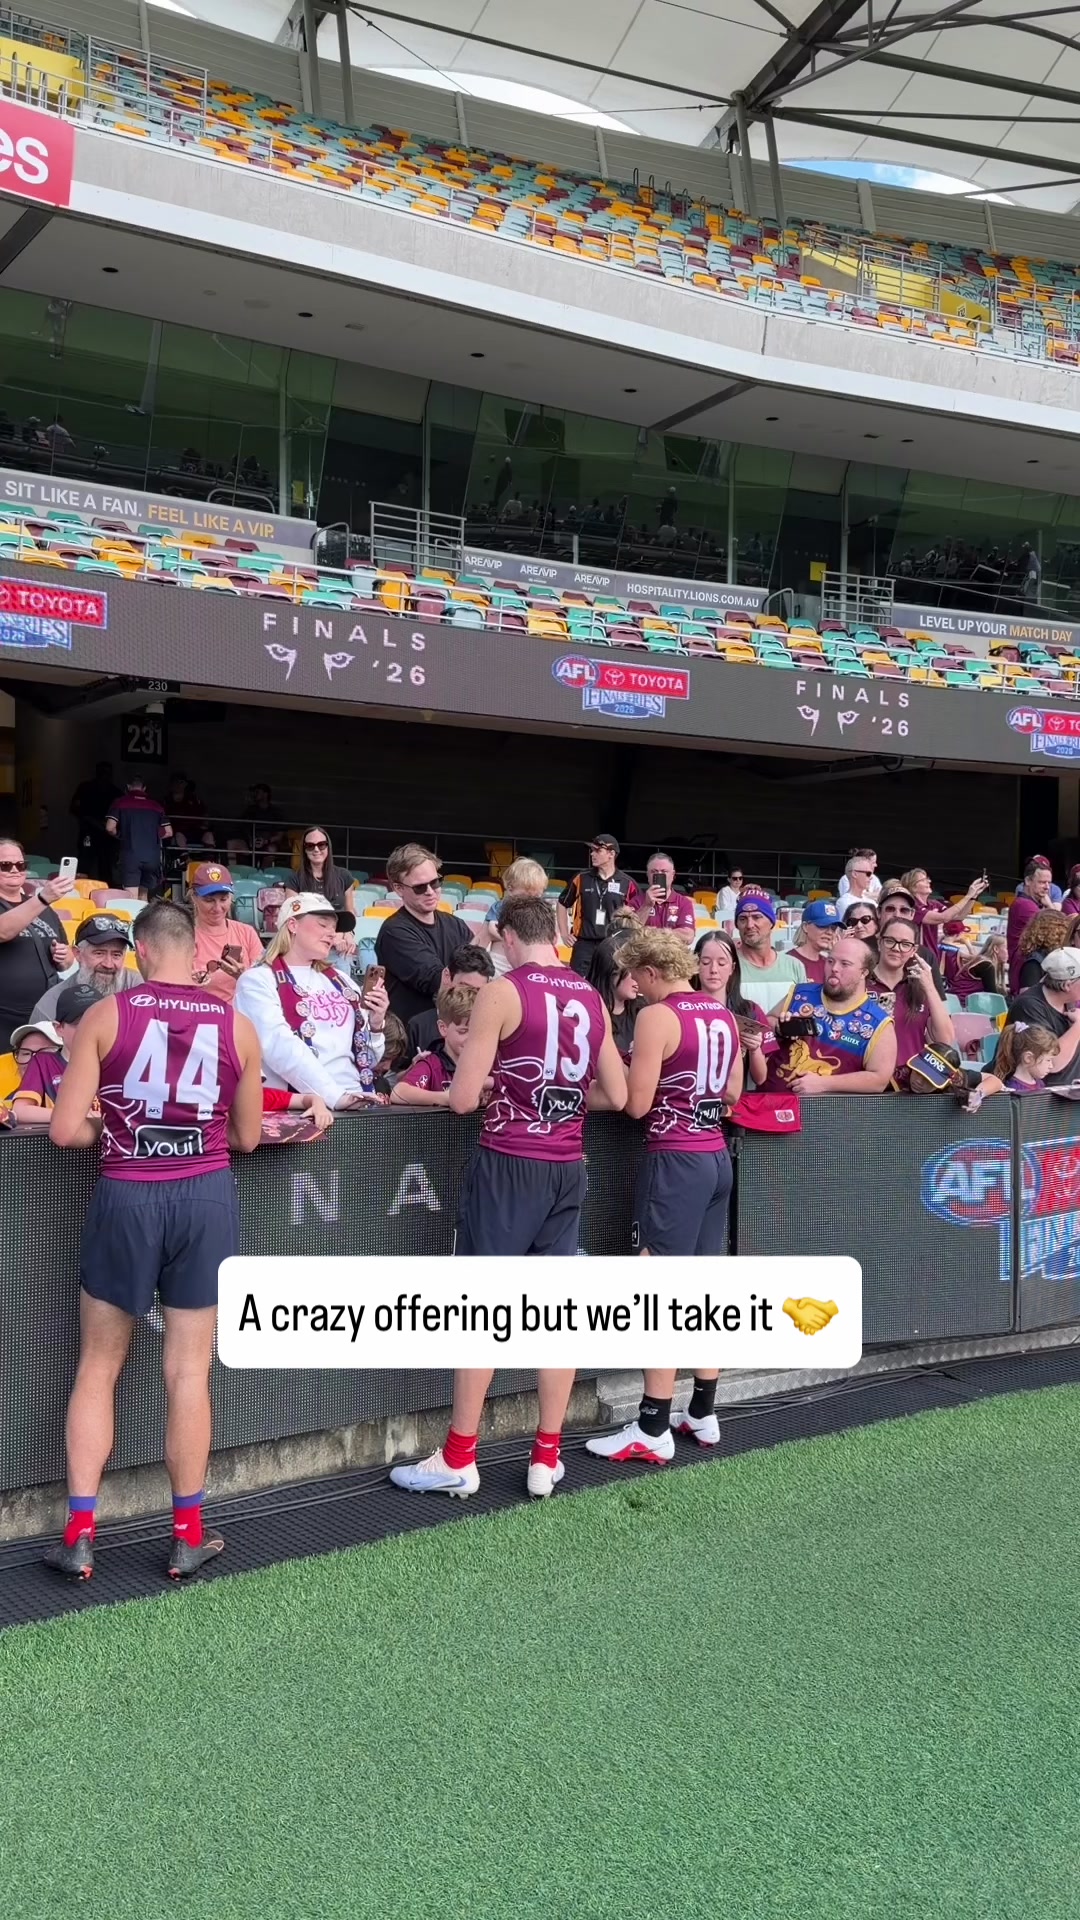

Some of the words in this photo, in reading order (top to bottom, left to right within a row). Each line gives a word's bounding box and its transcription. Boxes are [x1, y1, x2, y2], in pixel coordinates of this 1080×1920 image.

[5, 480, 35, 499] SIT
[41, 486, 80, 506] LIKE
[83, 494, 97, 509] A
[102, 496, 142, 517] FAN.
[148, 504, 188, 524] FEEL
[193, 512, 229, 531] LIKE
[232, 519, 245, 534] A
[247, 521, 275, 538] VIP.
[18, 590, 98, 617] TOYOTA
[627, 583, 759, 608] HOSPITALITY.LIONS.COM.AU
[263, 612, 426, 651] FINALS
[920, 615, 955, 630] LEVEL
[958, 619, 974, 632] UP
[975, 620, 1007, 636] YOUR
[1009, 625, 1049, 640] MATCH
[1051, 629, 1073, 643] DAY
[148, 680, 168, 691] 230
[556, 662, 596, 680] AFL
[630, 673, 683, 690] TOYOTA
[796, 680, 909, 708] FINALS
[1009, 712, 1042, 728] AFL
[127, 724, 162, 756] 231
[160, 999, 225, 1015] HYUNDAI
[543, 992, 591, 1083] 13
[841, 1035, 860, 1046] CALTEX
[123, 1018, 220, 1120] 44
[694, 1018, 732, 1095] 10
[924, 1053, 945, 1073] LIONS
[144, 1135, 194, 1156] youi
